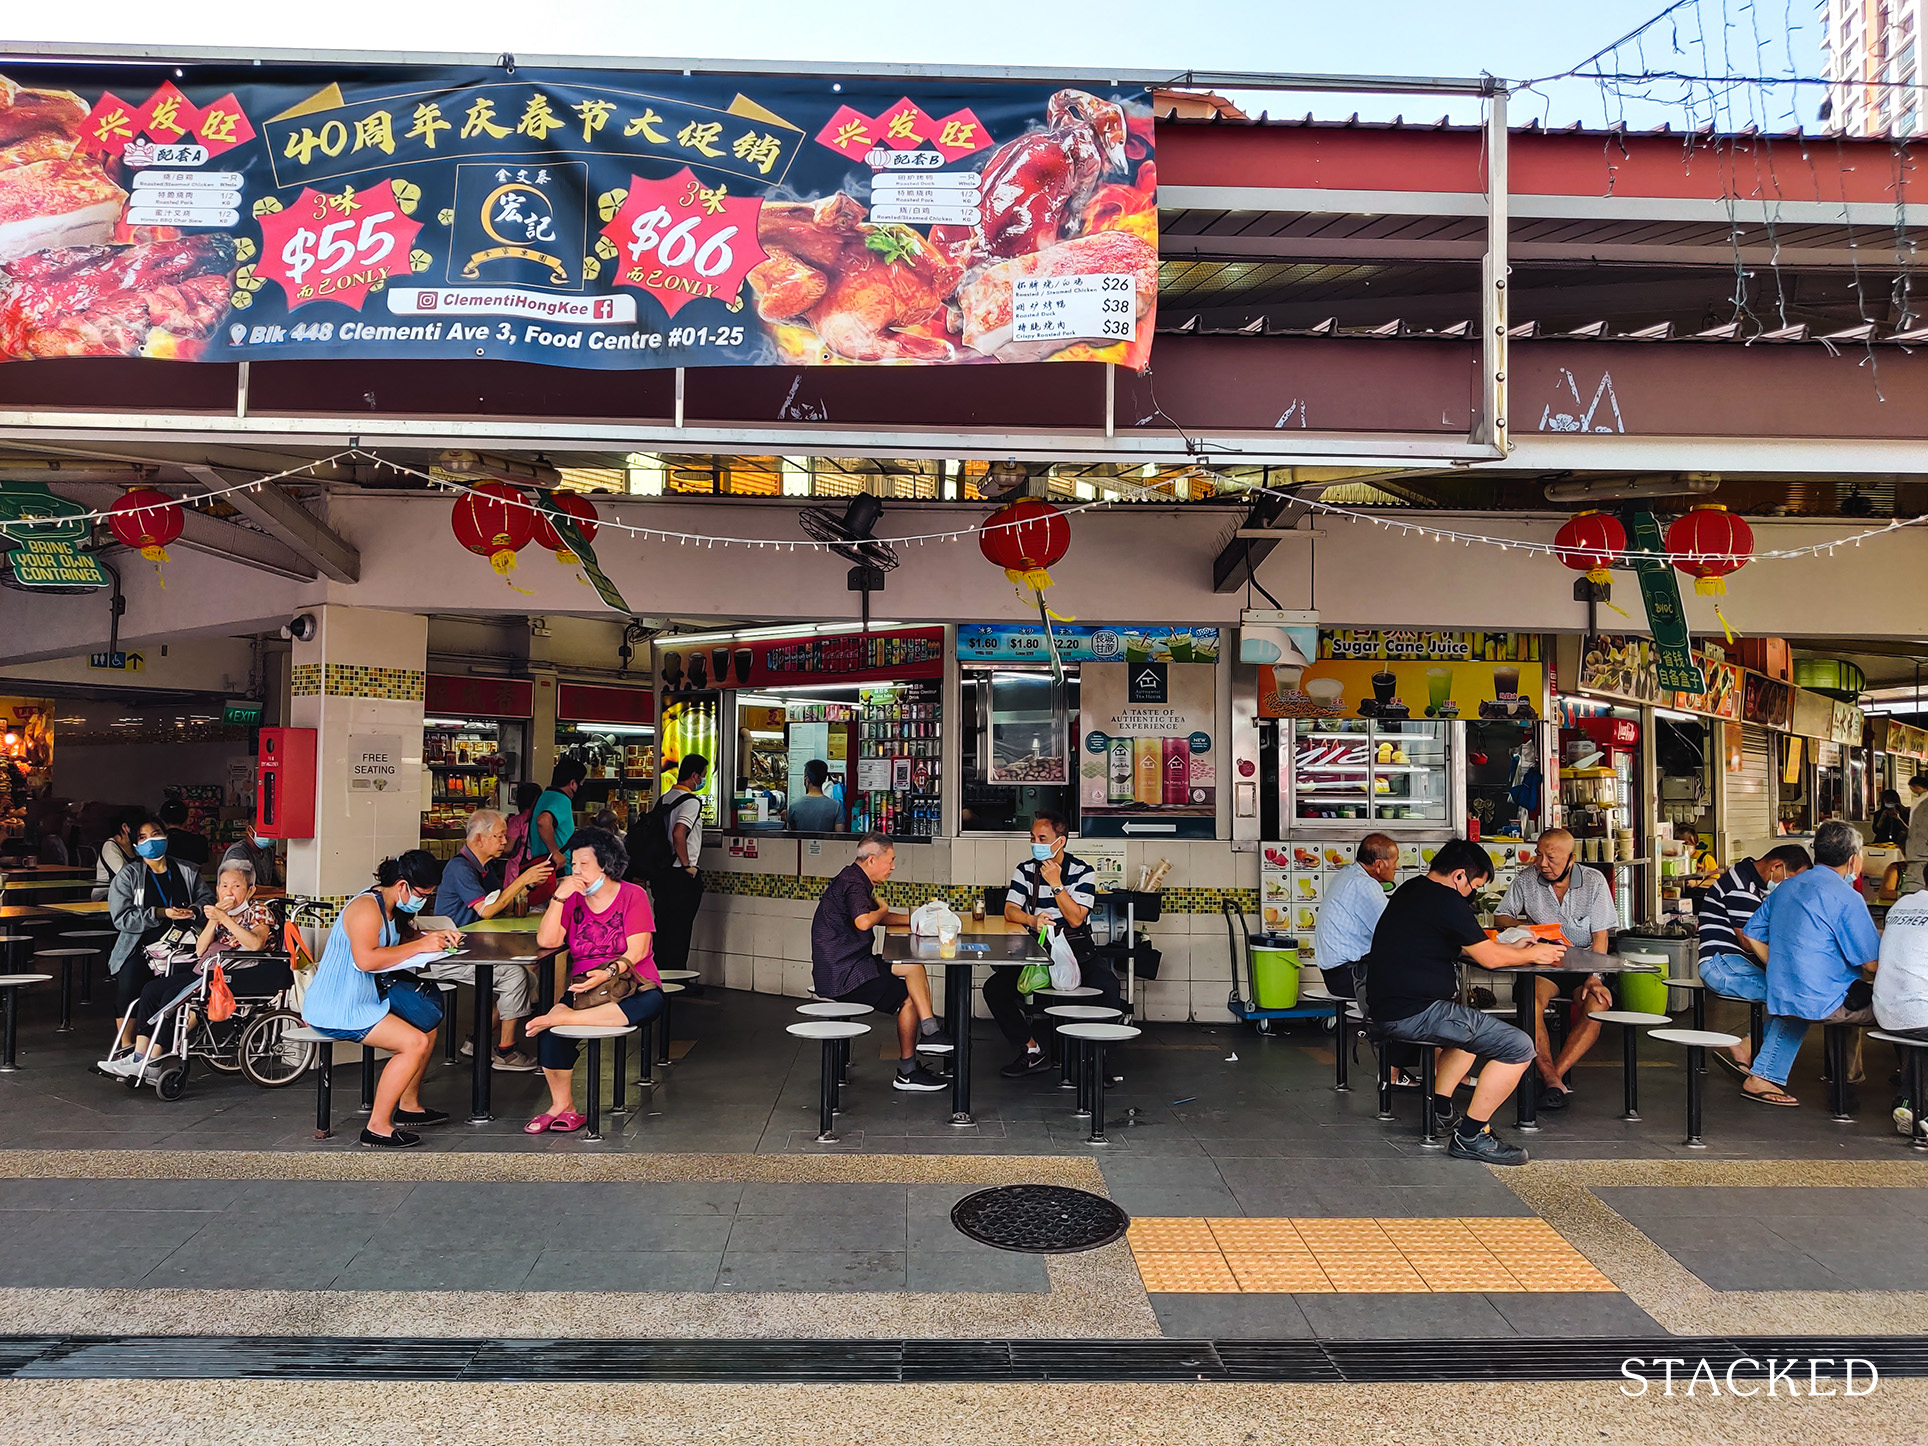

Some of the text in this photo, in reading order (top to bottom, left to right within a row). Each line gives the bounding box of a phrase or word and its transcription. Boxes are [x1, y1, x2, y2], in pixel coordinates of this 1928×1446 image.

[92, 95, 241, 143] 兴发旺
[832, 108, 977, 149] 兴发旺
[157, 148, 201, 162] 配套A
[893, 153, 940, 166] 配套B
[495, 168, 552, 184] 金文泰
[221, 192, 234, 200] 1/2
[313, 186, 363, 220] 3味
[678, 180, 728, 216] 3味
[493, 192, 556, 242] 宏記
[281, 211, 396, 284] $55
[626, 205, 739, 278] $66
[1102, 276, 1129, 292] $26
[443, 292, 588, 316] ClementiHongKee
[1102, 298, 1130, 314] $38
[1102, 318, 1130, 335] $38
[249, 322, 745, 350] Blk 448 Clementi Ave 3, Food Centre #01-25
[28, 540, 74, 554] BRING
[16, 554, 96, 568] YOUR OWN
[20, 567, 102, 582] CONTAINER
[968, 638, 998, 649] $1.60
[1010, 638, 1039, 649] $1.80
[1333, 638, 1468, 655] Sugar Cane Juice
[1659, 668, 1700, 689] 自备盒子
[234, 710, 257, 722] EXIT
[362, 753, 388, 762] FREE
[354, 765, 395, 774] SEATING
